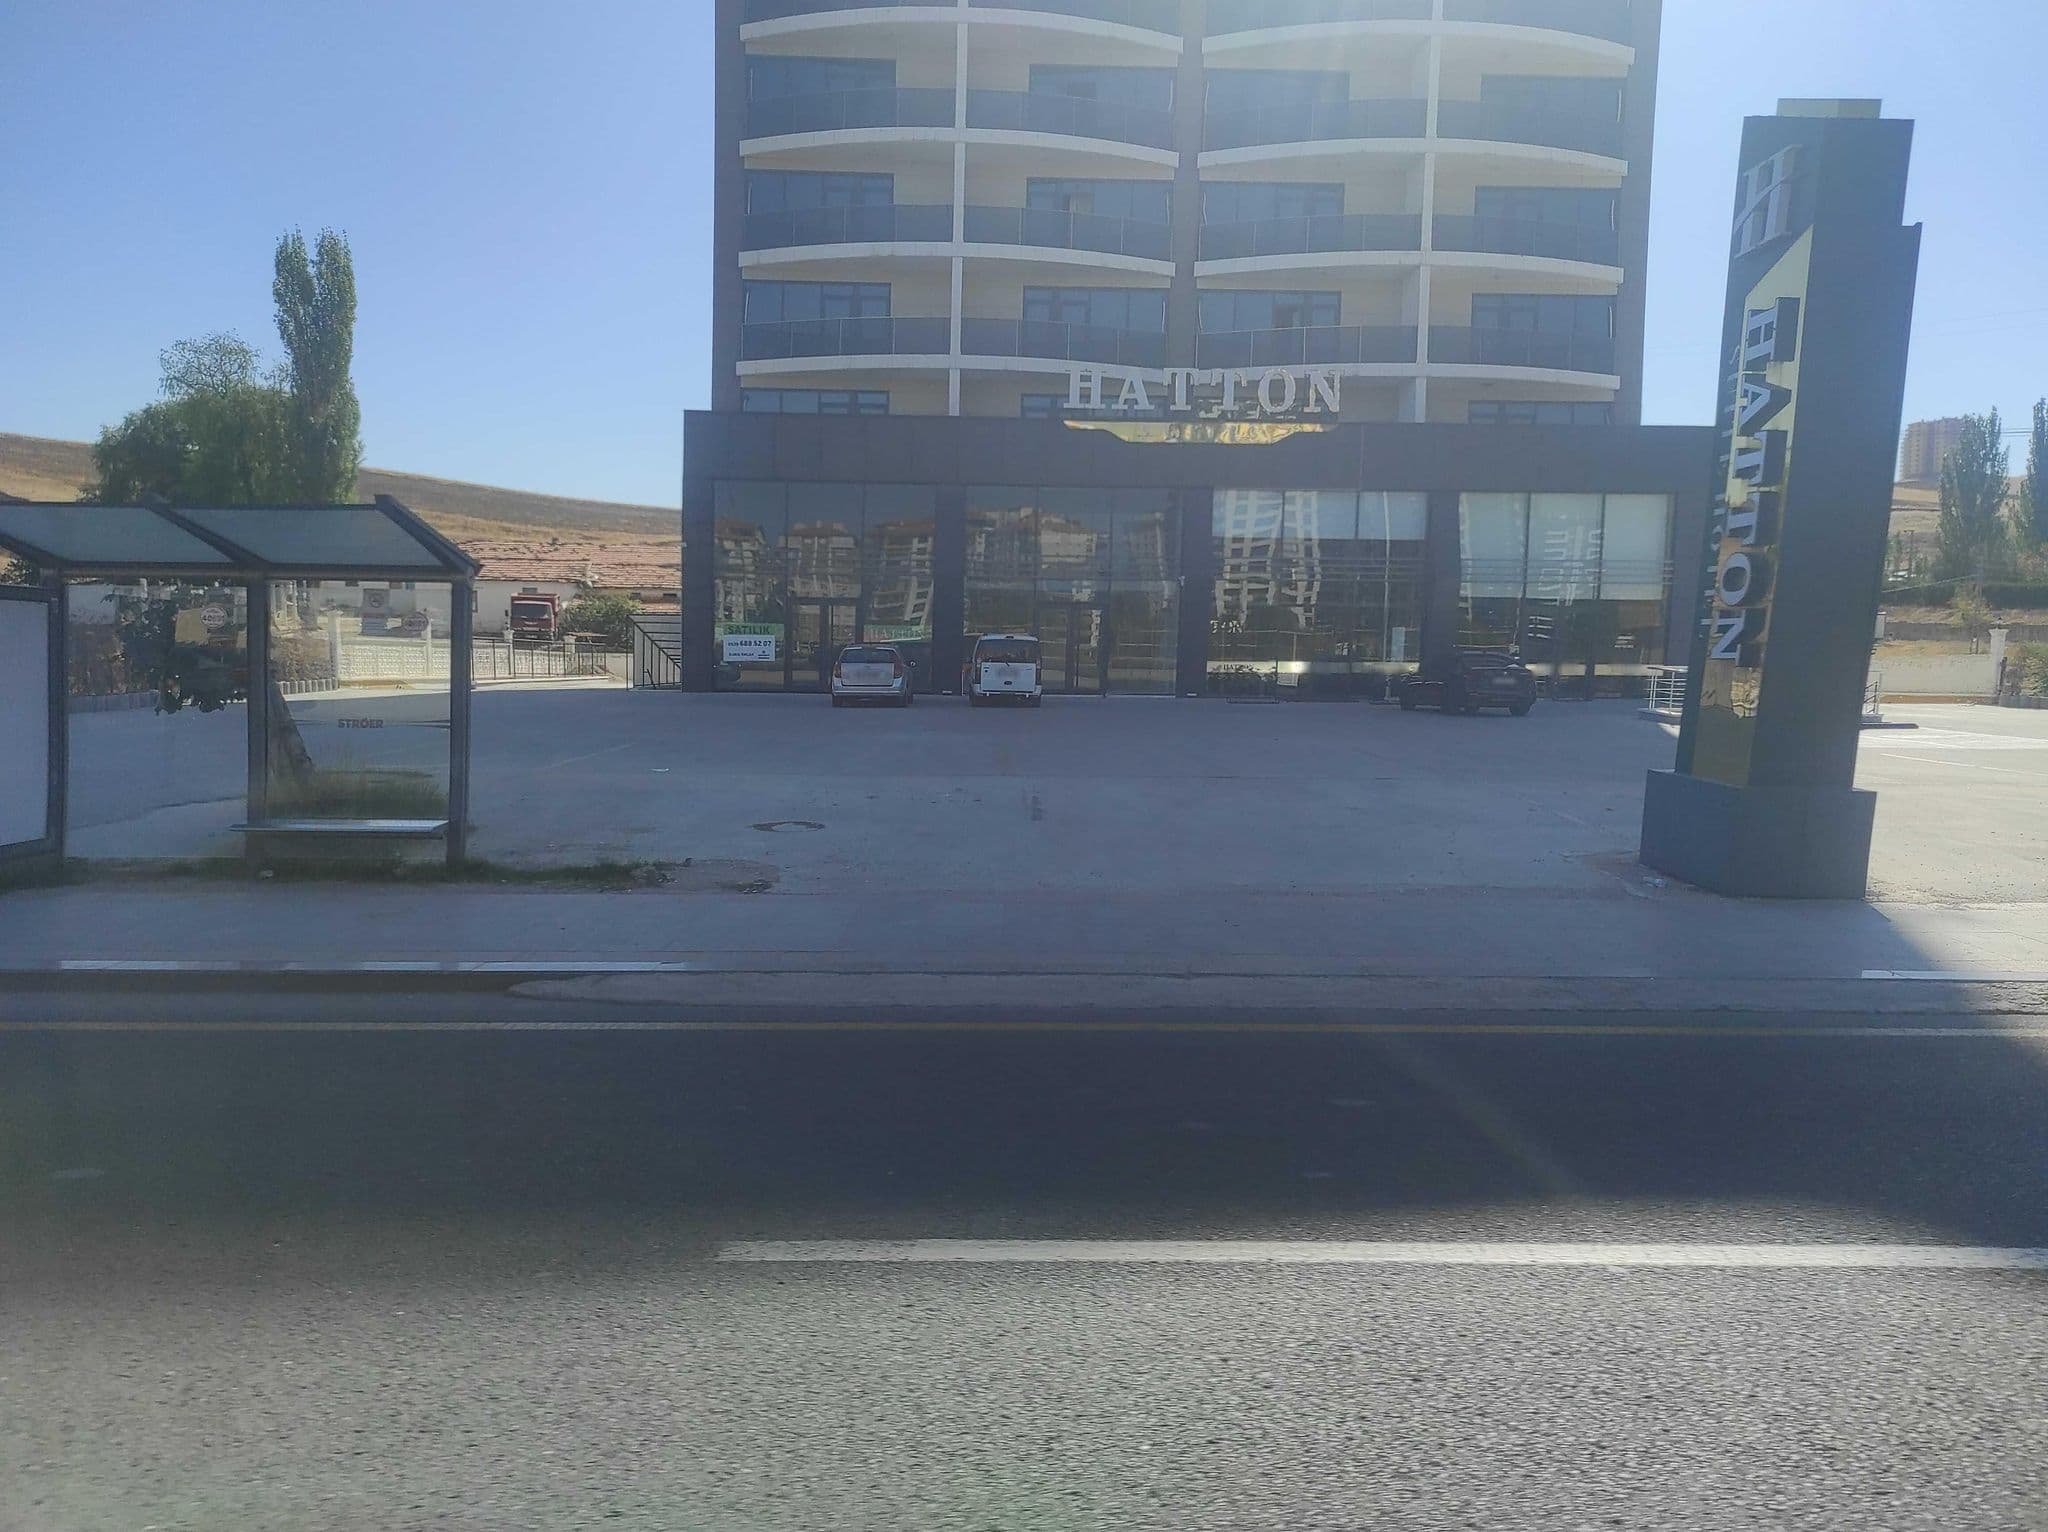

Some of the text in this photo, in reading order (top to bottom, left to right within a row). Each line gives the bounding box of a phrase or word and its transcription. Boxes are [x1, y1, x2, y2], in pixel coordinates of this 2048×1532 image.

[1063, 367, 1344, 413] HATTON
[1710, 297, 1780, 667] HATTON
[727, 625, 770, 635] SATILIK
